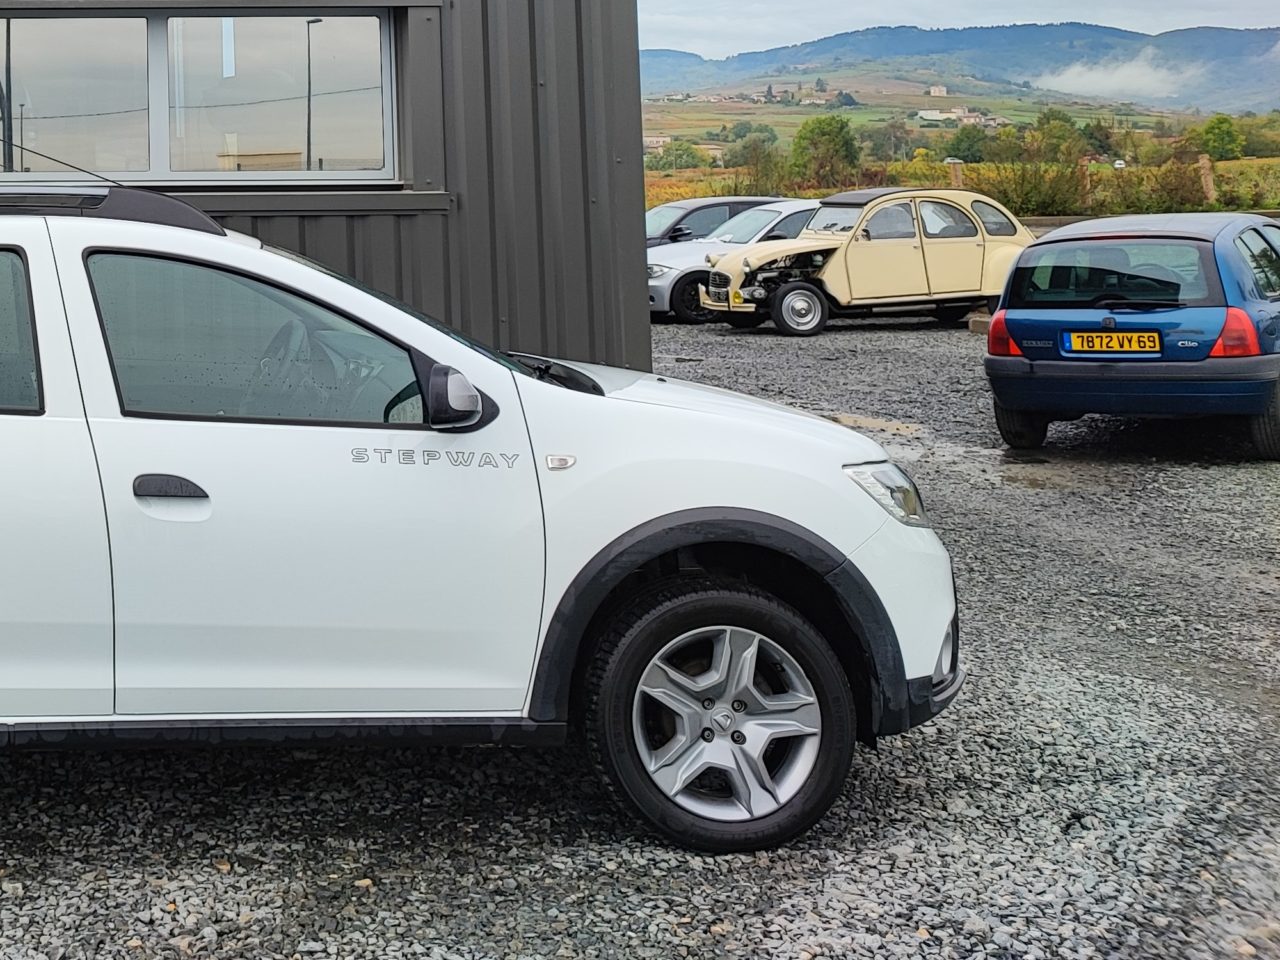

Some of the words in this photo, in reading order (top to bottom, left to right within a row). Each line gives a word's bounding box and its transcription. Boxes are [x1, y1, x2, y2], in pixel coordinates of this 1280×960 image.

[1076, 335, 1115, 349] 7872
[1115, 335, 1134, 348] VY
[1137, 335, 1157, 348] 69
[350, 447, 520, 469] STEPWAY
